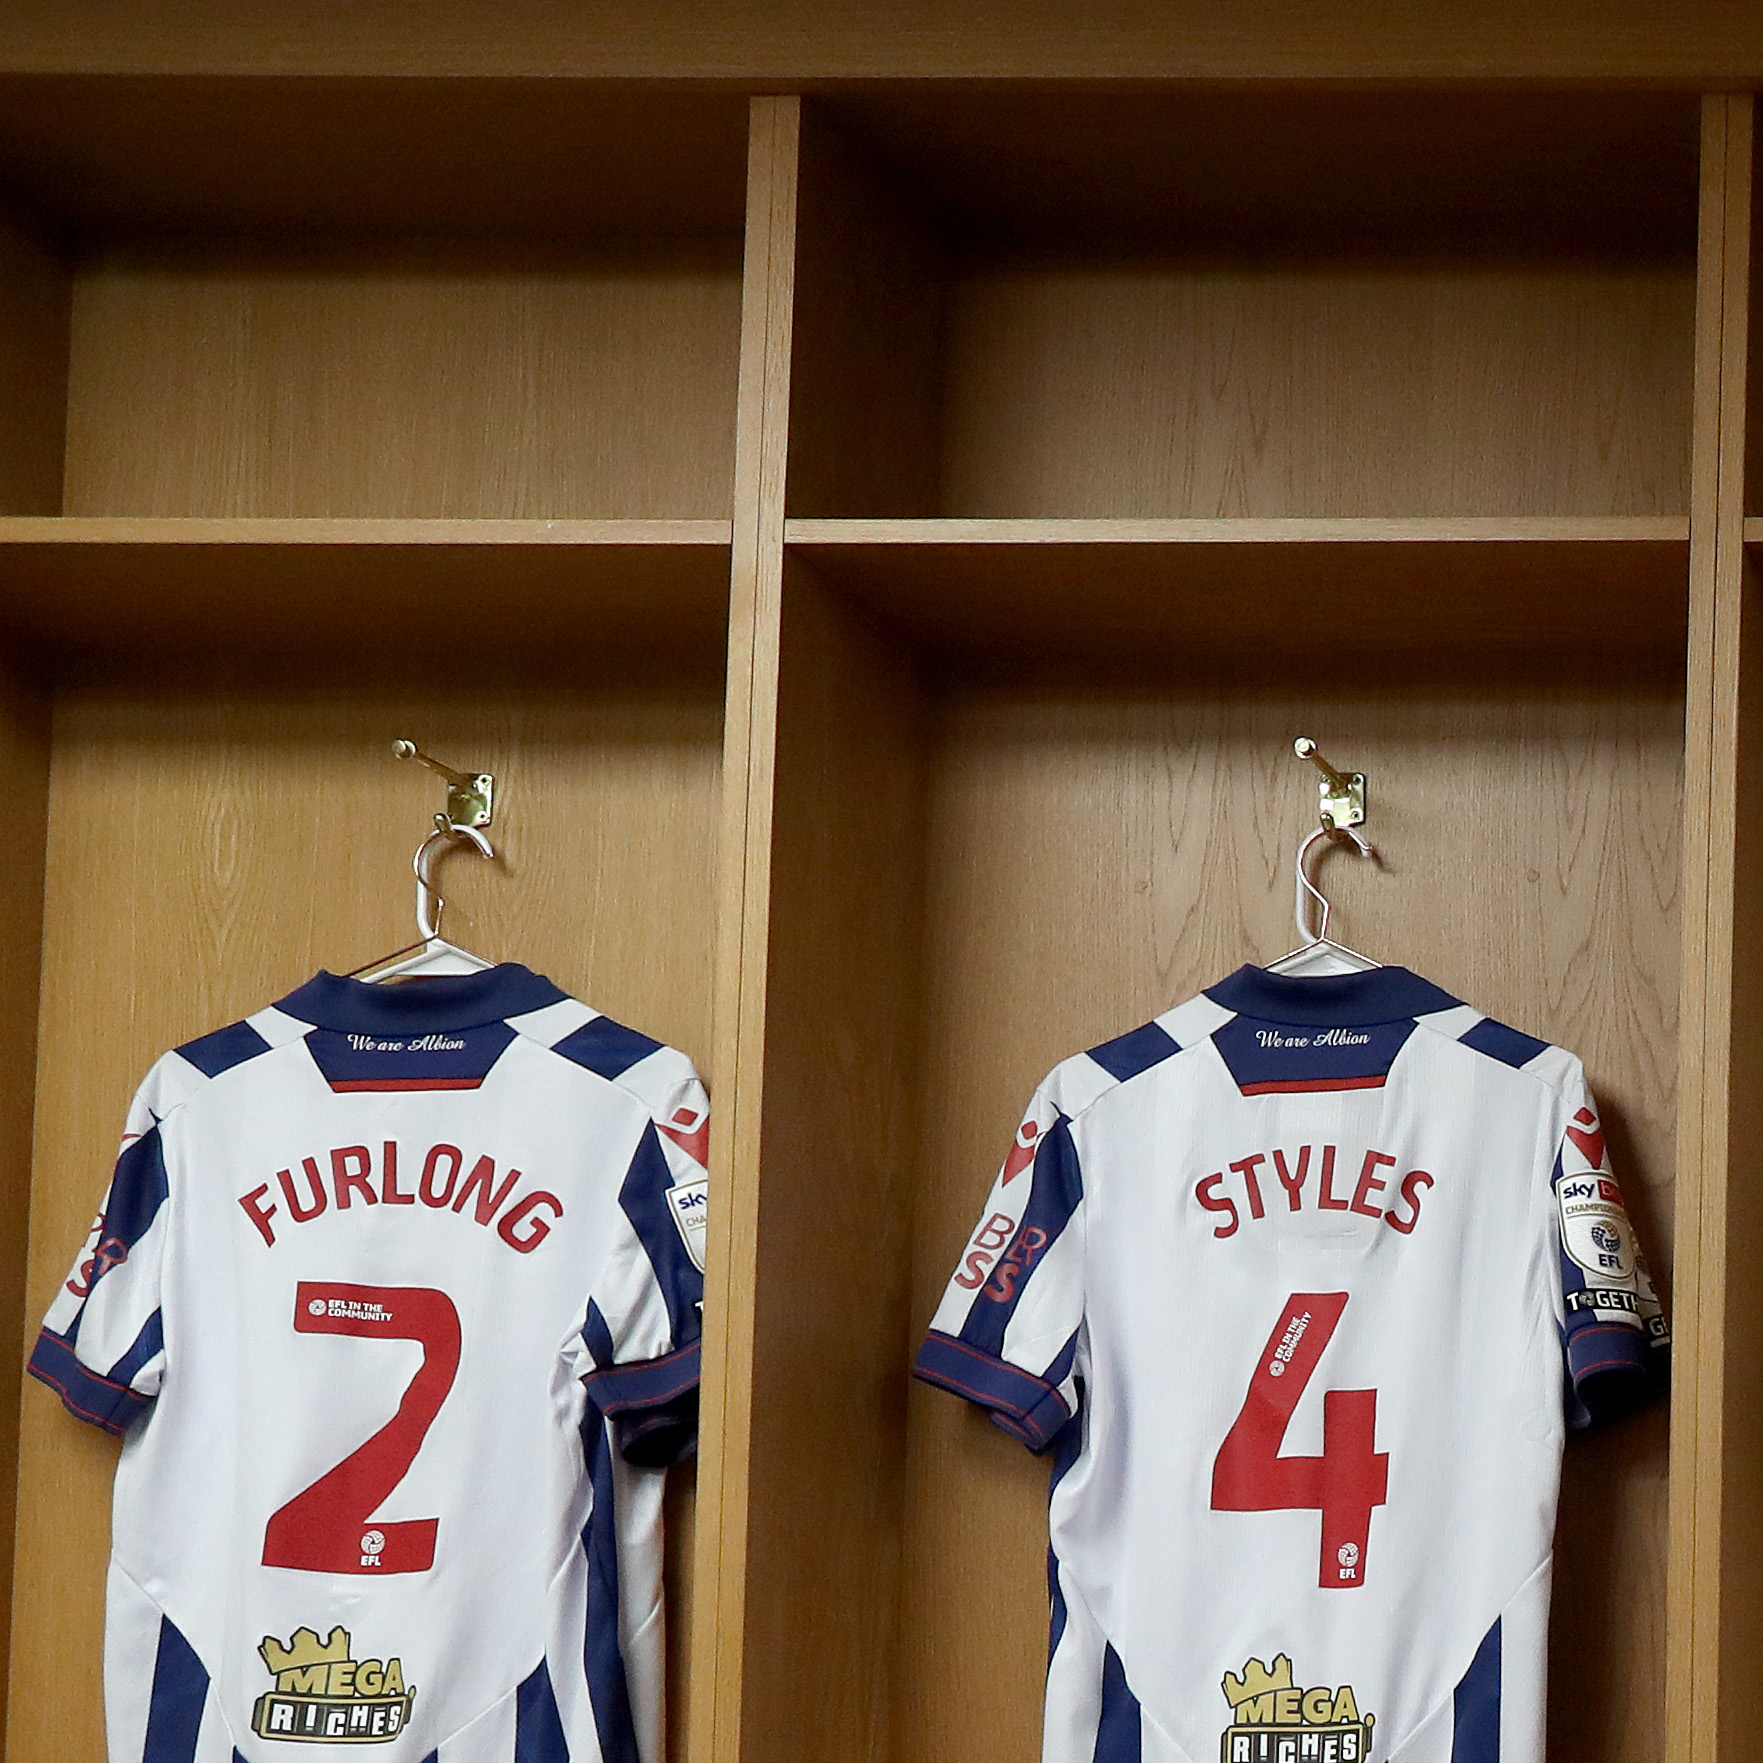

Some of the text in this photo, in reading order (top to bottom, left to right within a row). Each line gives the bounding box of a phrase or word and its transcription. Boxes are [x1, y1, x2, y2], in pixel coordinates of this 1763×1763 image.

[347, 1034, 466, 1052] We are Albion
[1256, 1028, 1371, 1048] We are Albion
[238, 1140, 564, 1255] FURLONG
[1195, 1144, 1435, 1239] STYLES
[1563, 1182, 1596, 1199] sky
[1598, 1253, 1625, 1270] EFL
[327, 1308, 393, 1322] COMMUNITY
[328, 1299, 384, 1313] EFL IN THE
[261, 1280, 462, 1575] 2
[1210, 1291, 1389, 1588] 4
[360, 1554, 382, 1567] EFL
[1339, 1568, 1357, 1580] EFL
[277, 1658, 406, 1697] MEGA
[1235, 1685, 1360, 1725] MEGA
[270, 1702, 402, 1737] RICHES
